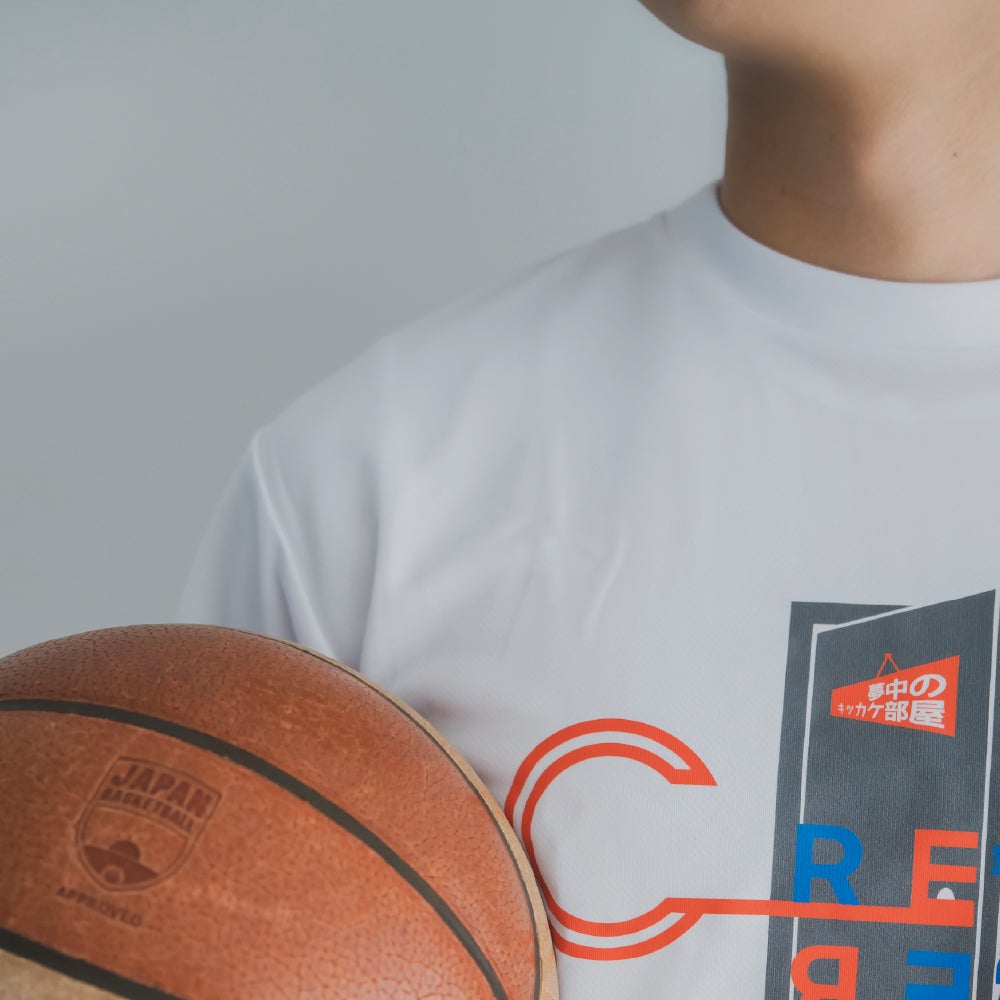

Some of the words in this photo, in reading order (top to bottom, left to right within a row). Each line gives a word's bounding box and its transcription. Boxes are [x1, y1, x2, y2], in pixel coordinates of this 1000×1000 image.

[867, 673, 947, 702] 夢中の
[837, 699, 946, 730] キッカケ部屋
[100, 787, 195, 833] BASKETBALL
[111, 763, 213, 818] JAPAN
[55, 885, 143, 928] APPROVED
